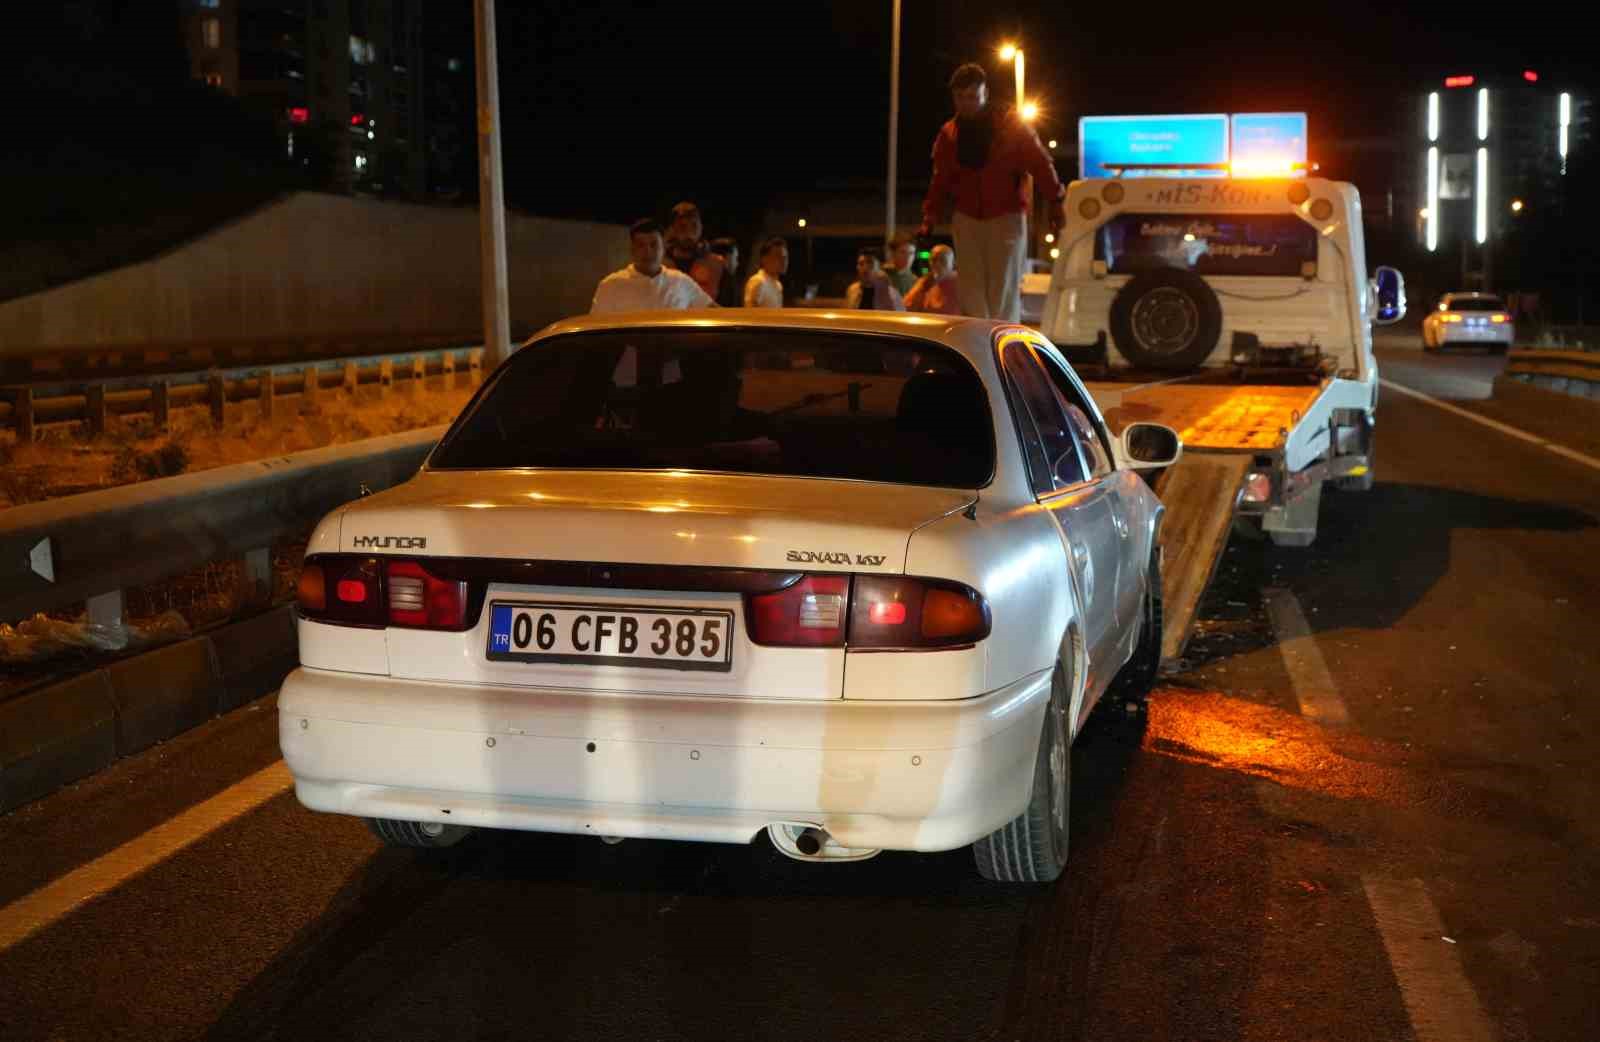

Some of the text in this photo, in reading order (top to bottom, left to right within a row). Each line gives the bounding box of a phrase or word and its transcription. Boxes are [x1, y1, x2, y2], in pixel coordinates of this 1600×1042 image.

[353, 536, 427, 549] HYUNDAI
[786, 550, 852, 565] SONATA
[494, 633, 509, 646] TR
[513, 612, 721, 657] 06 CFB 385
